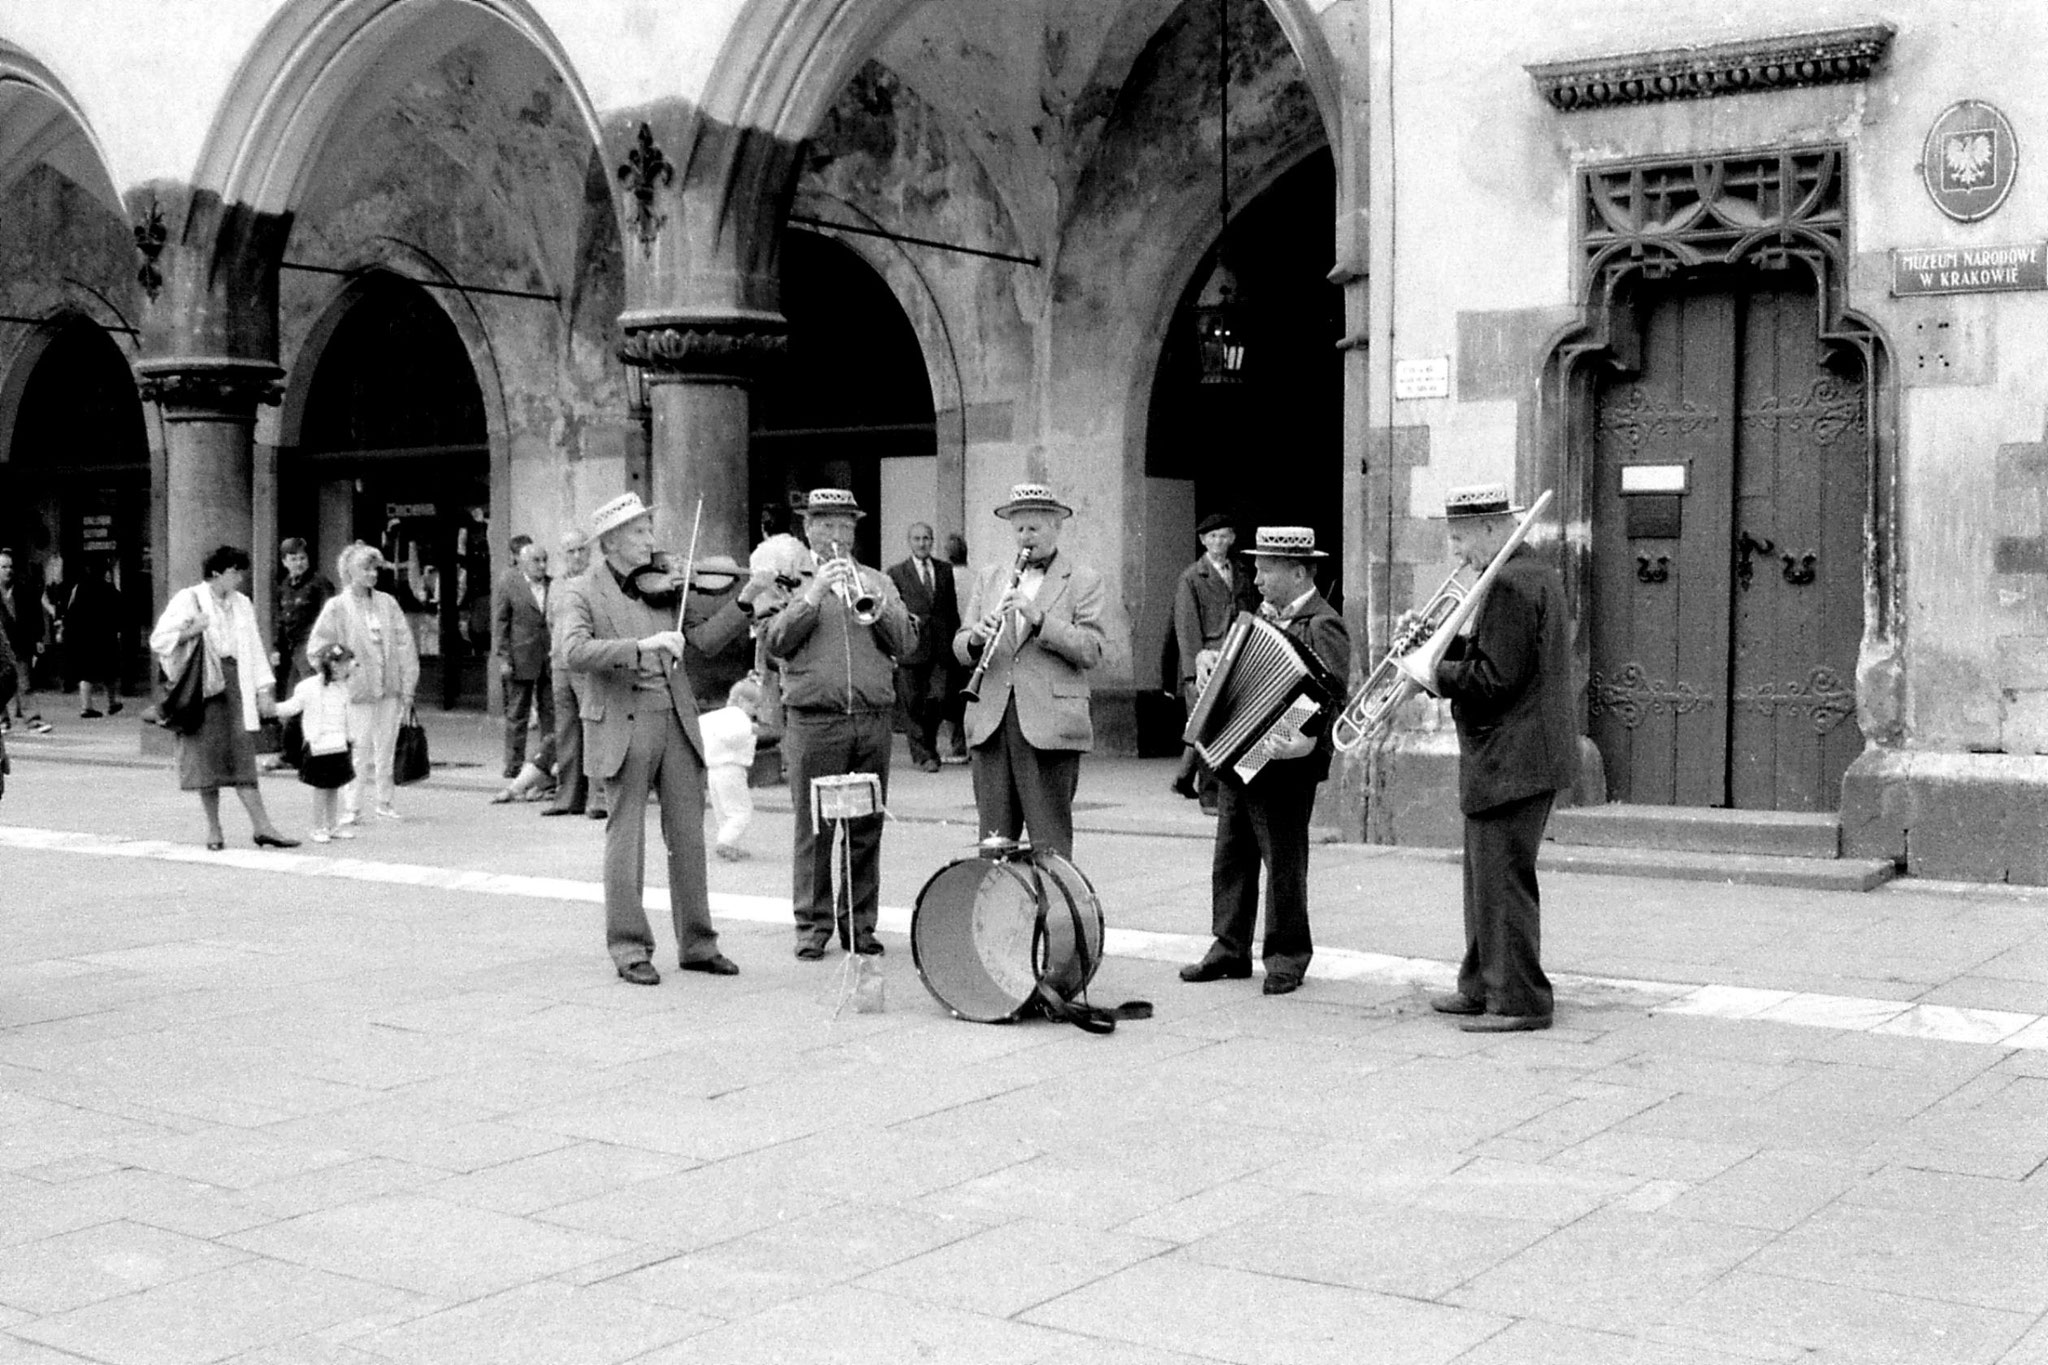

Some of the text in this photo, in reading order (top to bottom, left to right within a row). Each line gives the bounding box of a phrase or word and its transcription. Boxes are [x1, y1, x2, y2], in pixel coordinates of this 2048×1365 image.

[1902, 248, 2037, 271] MUZEUM NARODOWE
[1920, 267, 2019, 287] W KRAKOWIE
